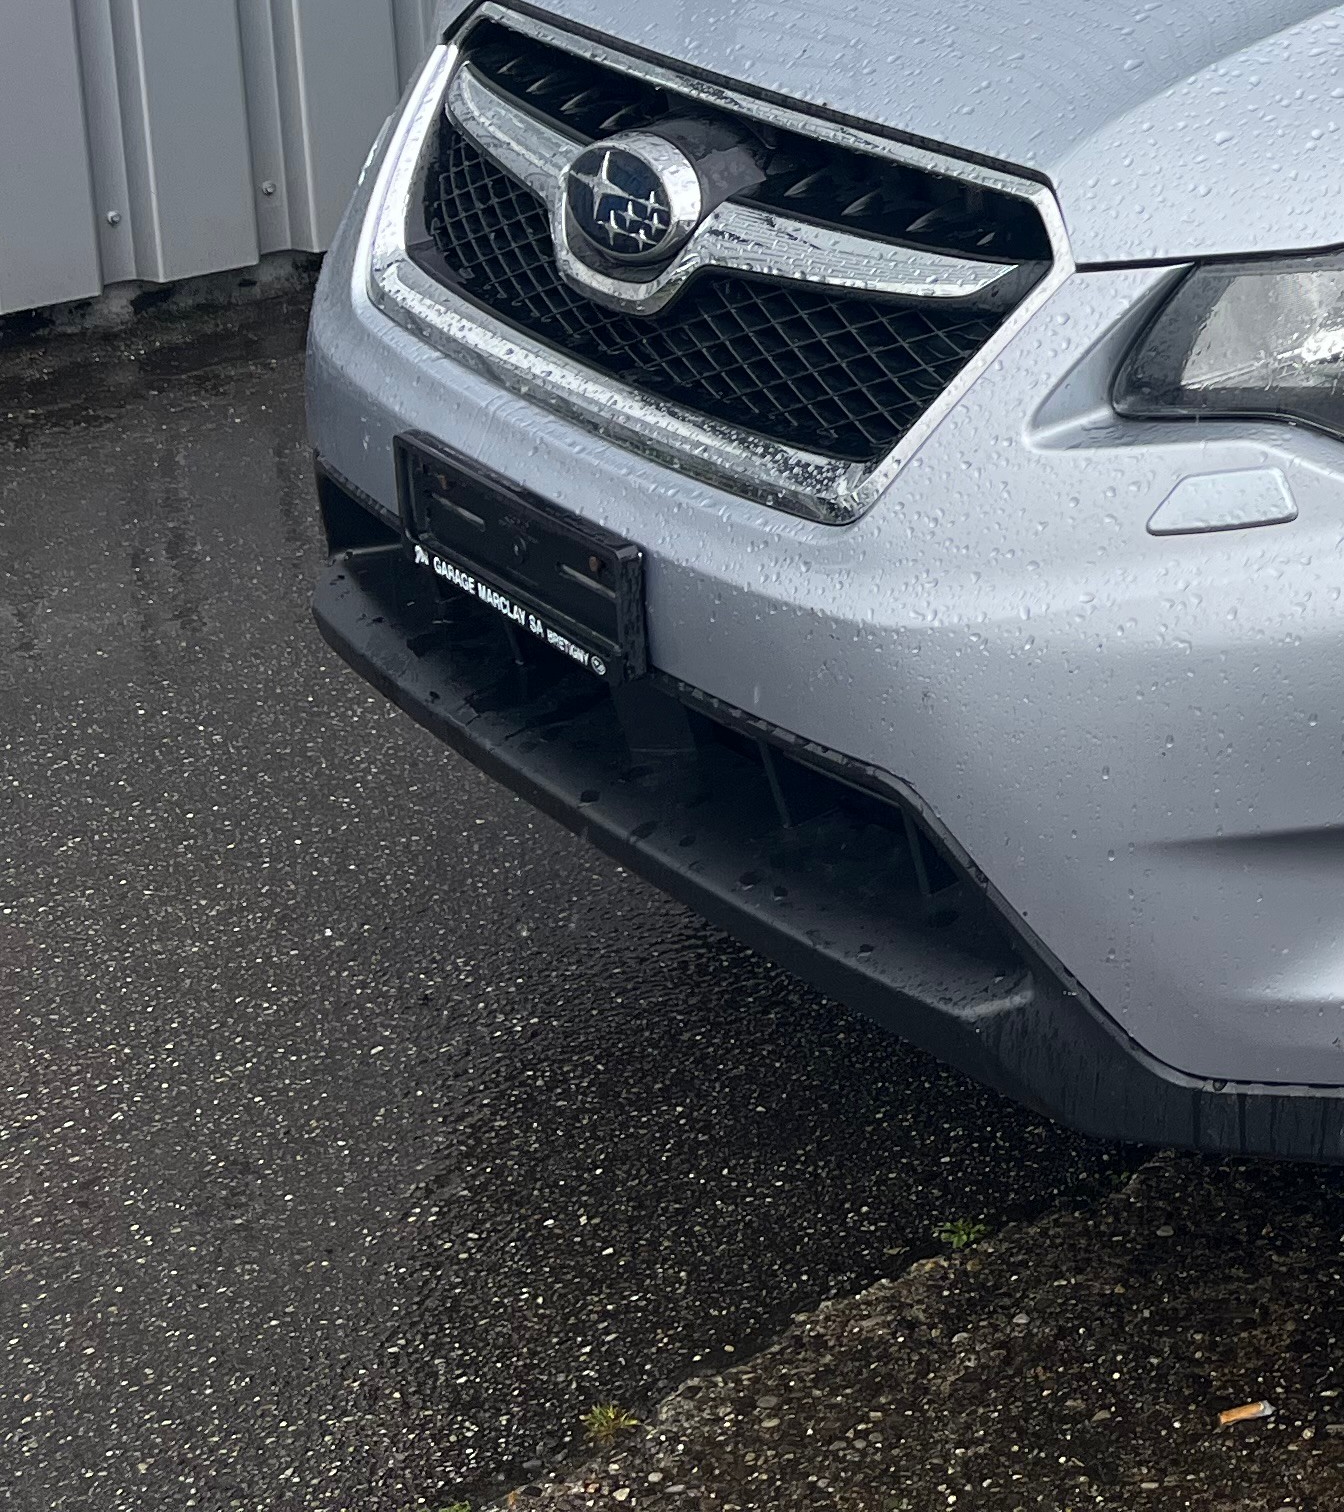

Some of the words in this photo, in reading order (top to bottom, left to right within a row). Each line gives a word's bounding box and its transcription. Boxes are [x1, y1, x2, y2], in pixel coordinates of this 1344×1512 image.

[433, 556, 475, 595] GARAGE
[478, 582, 526, 626] MARCLAY
[528, 614, 545, 638] SA
